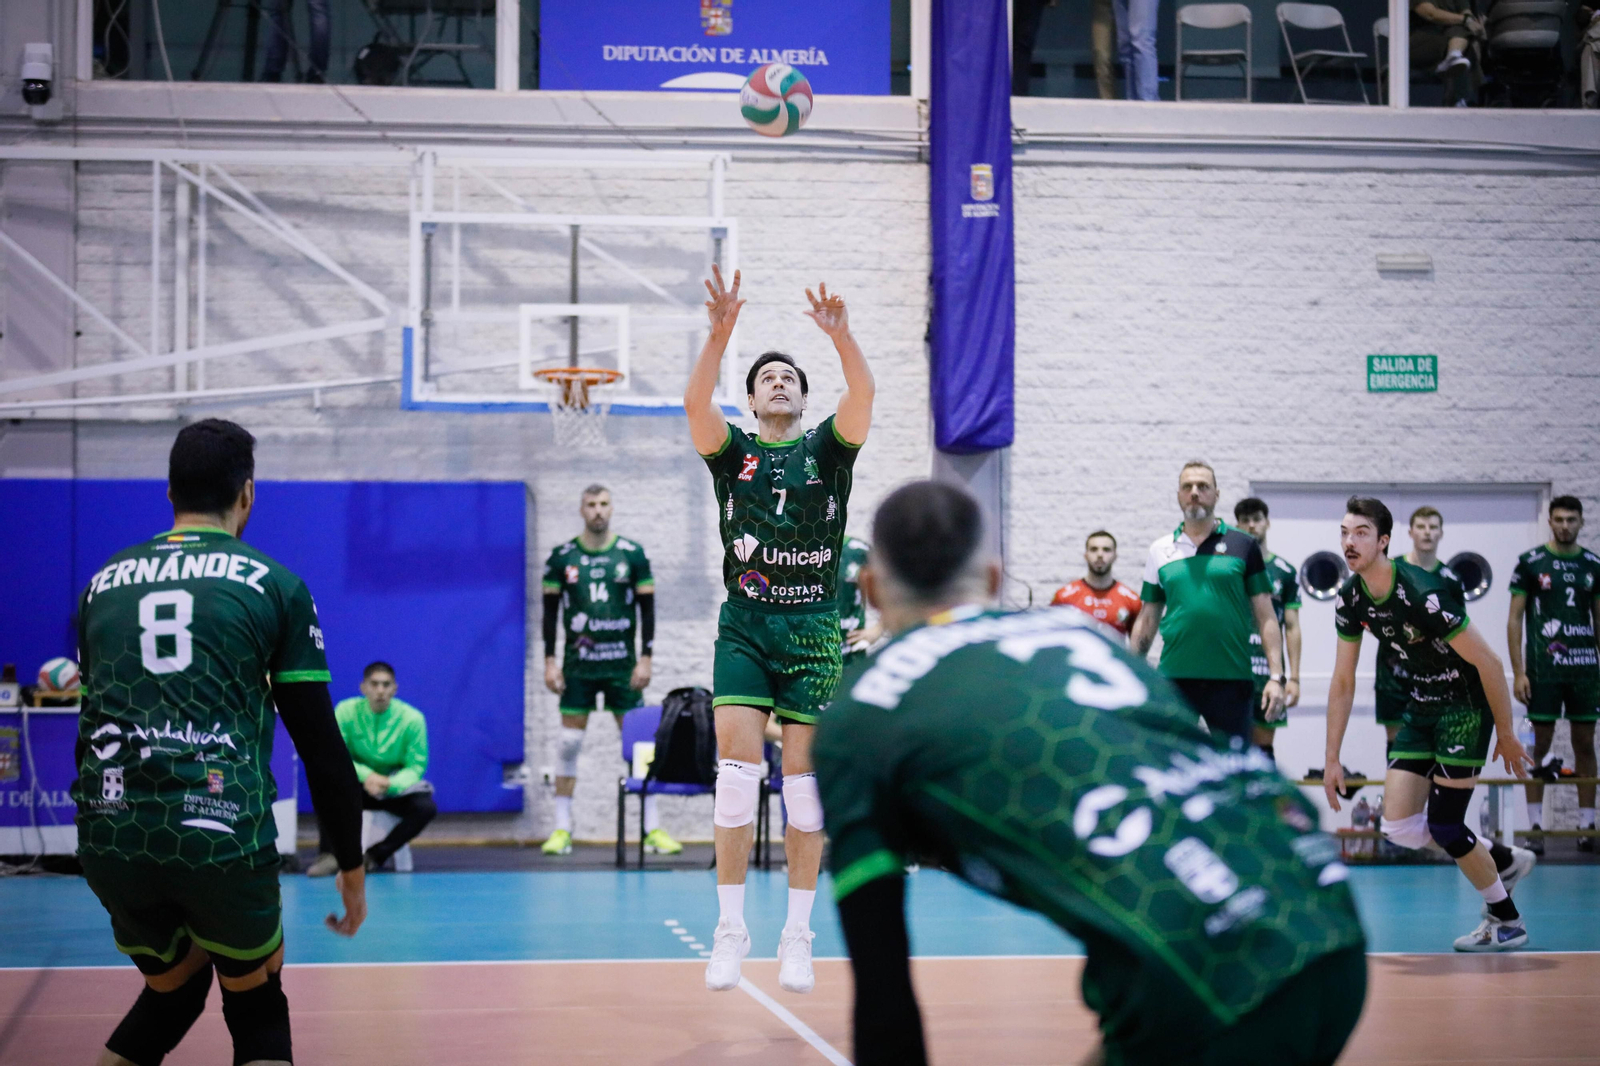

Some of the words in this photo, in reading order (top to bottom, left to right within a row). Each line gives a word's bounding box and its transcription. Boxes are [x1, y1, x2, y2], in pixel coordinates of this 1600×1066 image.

[602, 44, 716, 64] DIPUTACIÓN
[720, 49, 746, 64] DE
[750, 46, 829, 66] ALMERÍA
[1372, 357, 1415, 372] SALIDA
[1417, 357, 1433, 372] DE
[1369, 373, 1436, 389] EMERGENCIA
[772, 487, 787, 515] 7
[763, 546, 832, 568] Unicaja
[87, 551, 270, 604] FERNÁNDEZ
[589, 582, 609, 603] 14
[771, 585, 809, 596] COSTA
[810, 584, 824, 594] DE
[1565, 587, 1576, 607] 2
[138, 589, 194, 674] 8
[183, 803, 198, 813] DE
[199, 807, 238, 821] ALMERÍA
[184, 794, 240, 812] DIPUTACIÓN
